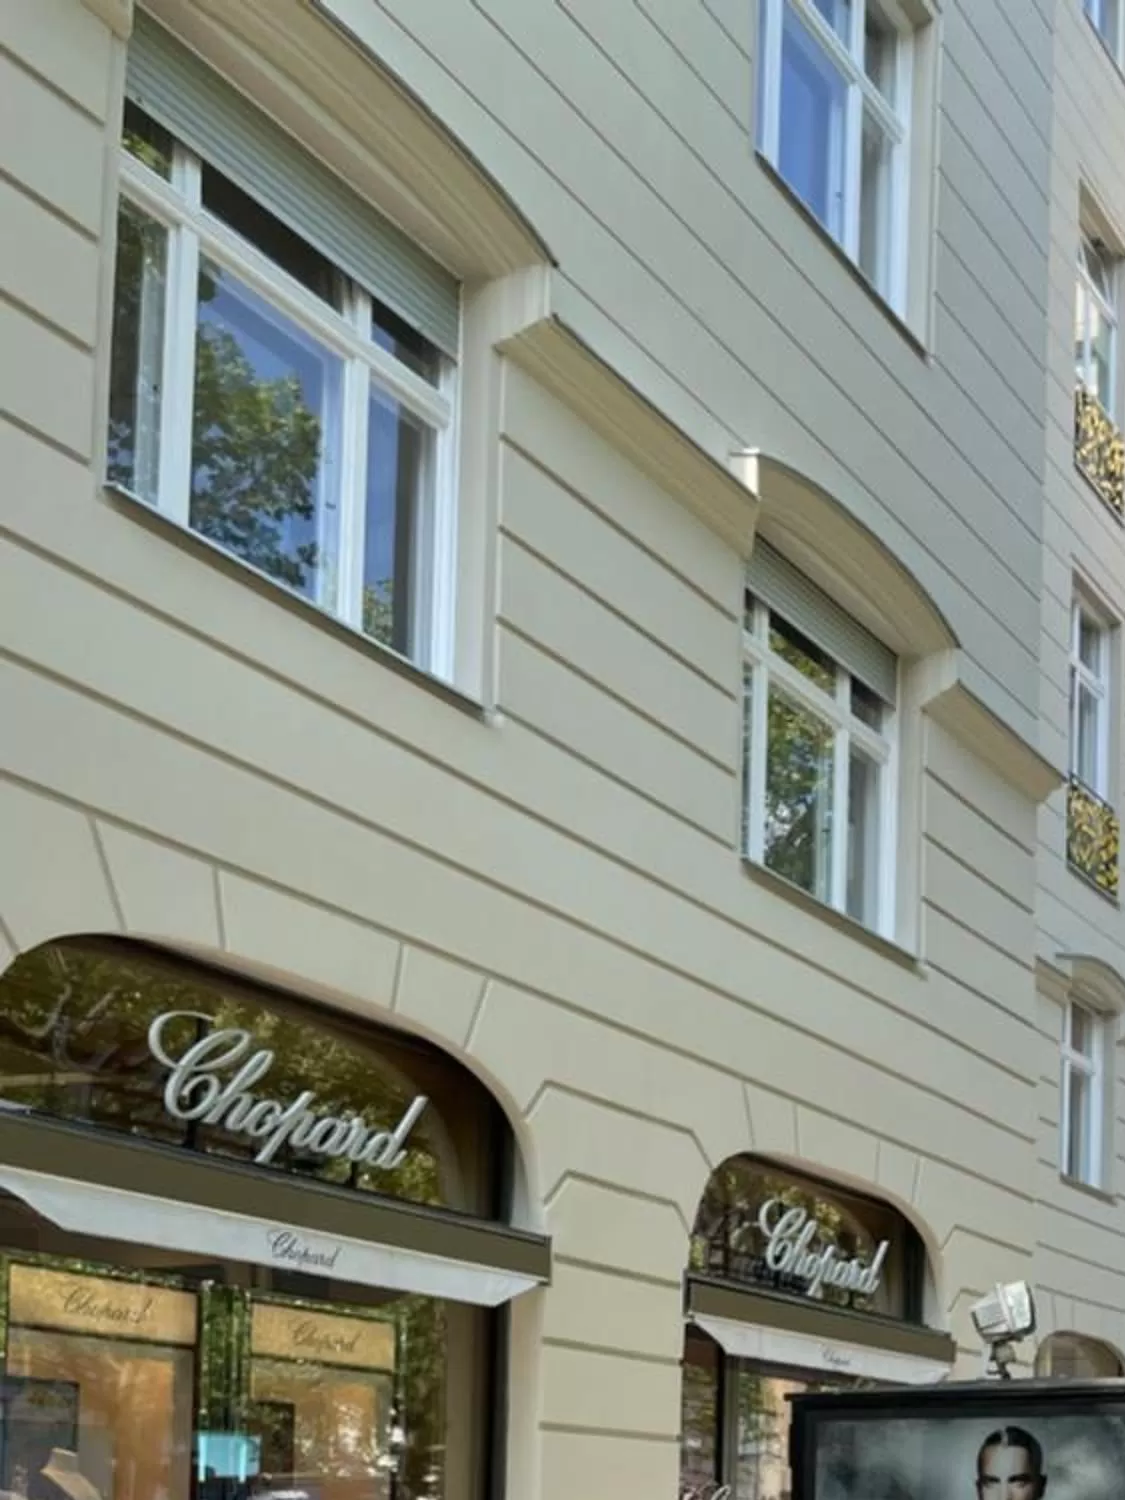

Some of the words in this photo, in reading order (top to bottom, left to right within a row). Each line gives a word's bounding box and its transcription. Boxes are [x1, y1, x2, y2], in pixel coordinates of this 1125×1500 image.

[148, 1010, 428, 1169] Chopard
[266, 1229, 342, 1270] Chopard
[758, 1199, 889, 1297] Chopard
